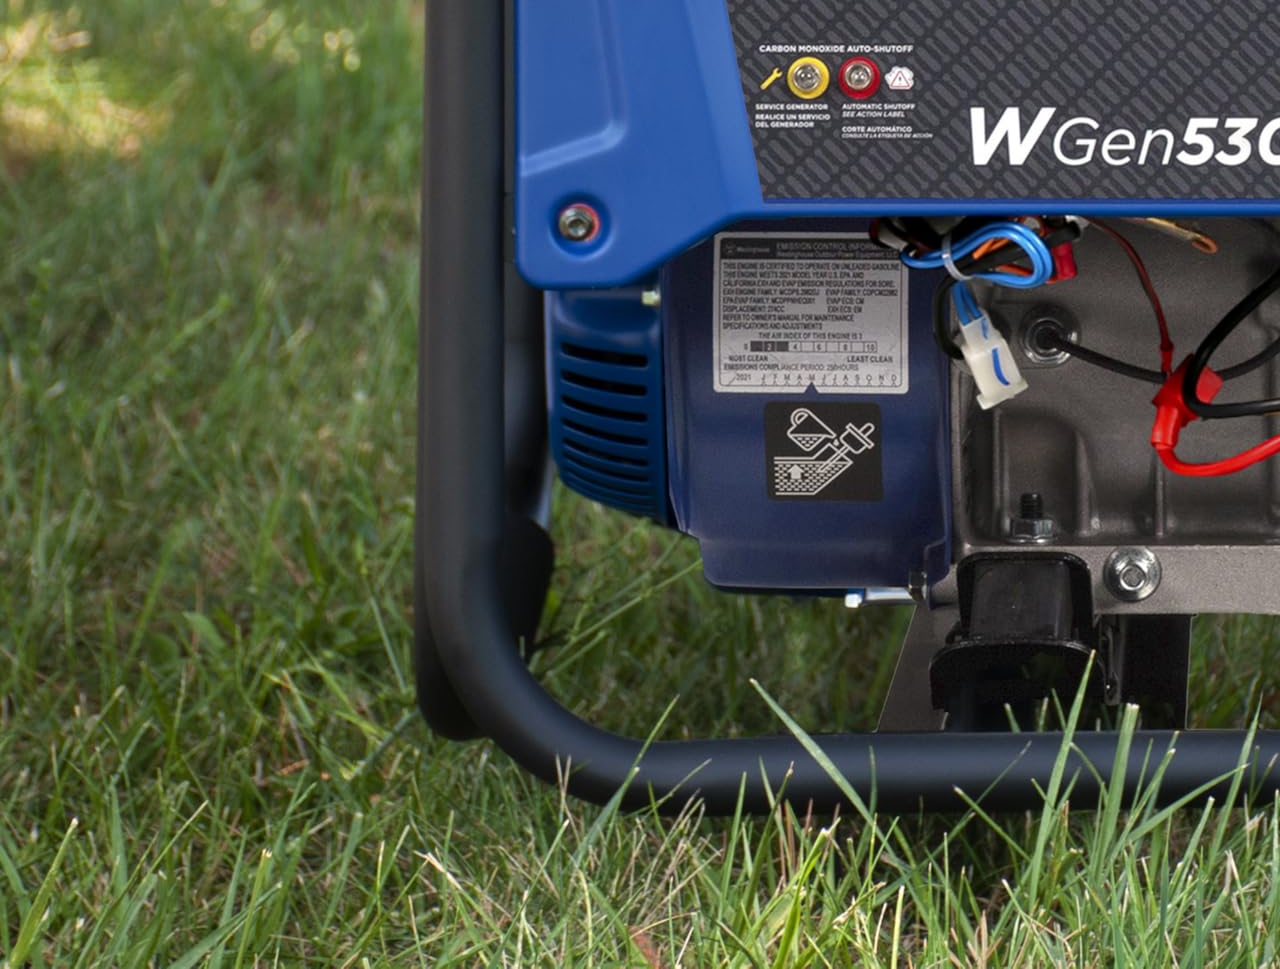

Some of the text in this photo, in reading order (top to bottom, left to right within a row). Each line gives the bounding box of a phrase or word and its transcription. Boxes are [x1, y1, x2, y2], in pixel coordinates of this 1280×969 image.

[759, 45, 913, 53] CARBON MONOXIDE AUTO-SHUTOFF
